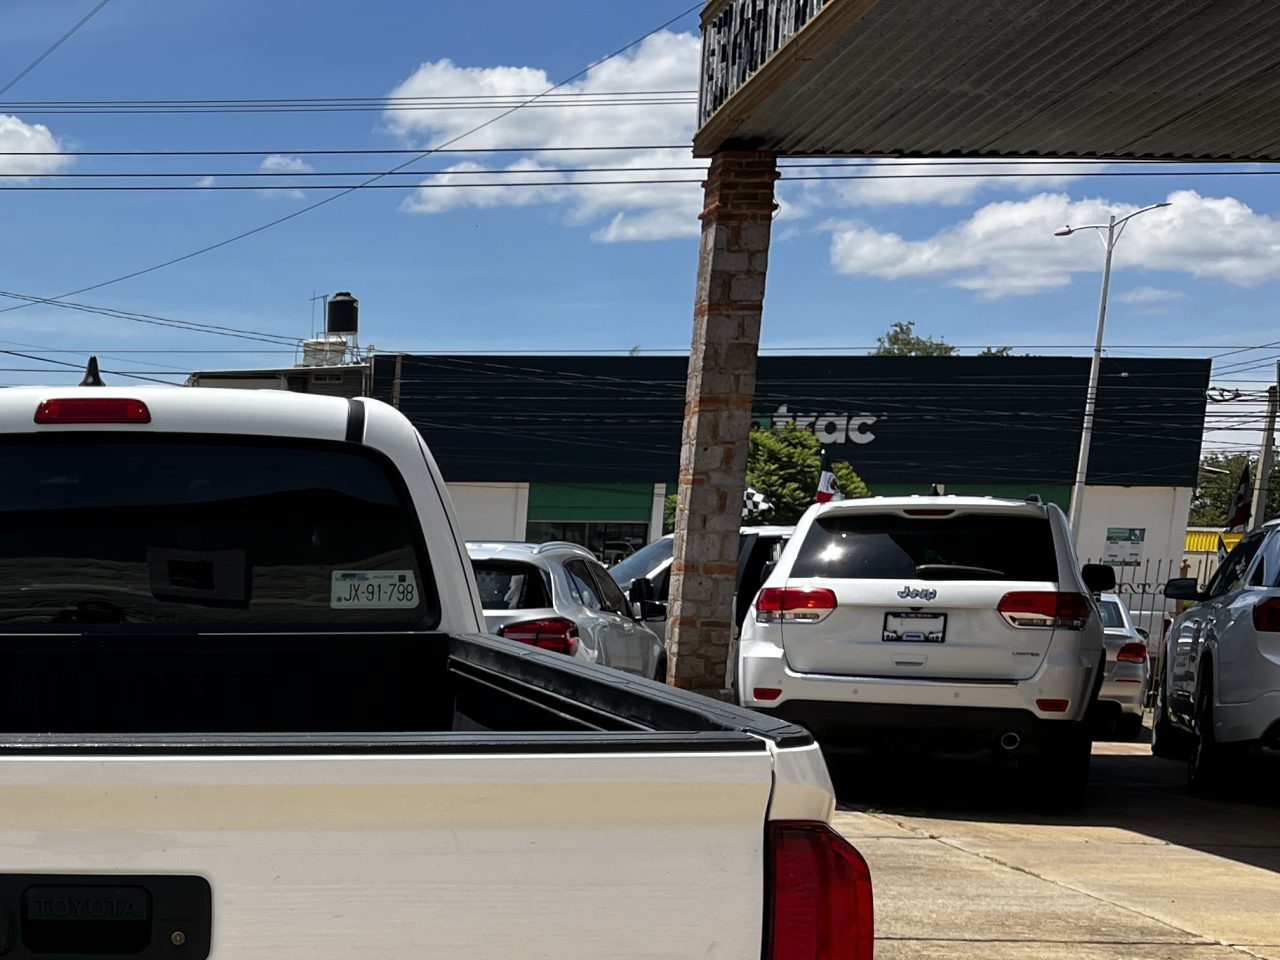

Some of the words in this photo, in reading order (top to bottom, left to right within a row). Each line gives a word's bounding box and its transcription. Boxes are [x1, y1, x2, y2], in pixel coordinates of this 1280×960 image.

[752, 404, 878, 444] trac
[344, 584, 414, 602] JX-91-798
[897, 586, 937, 601] Jeep
